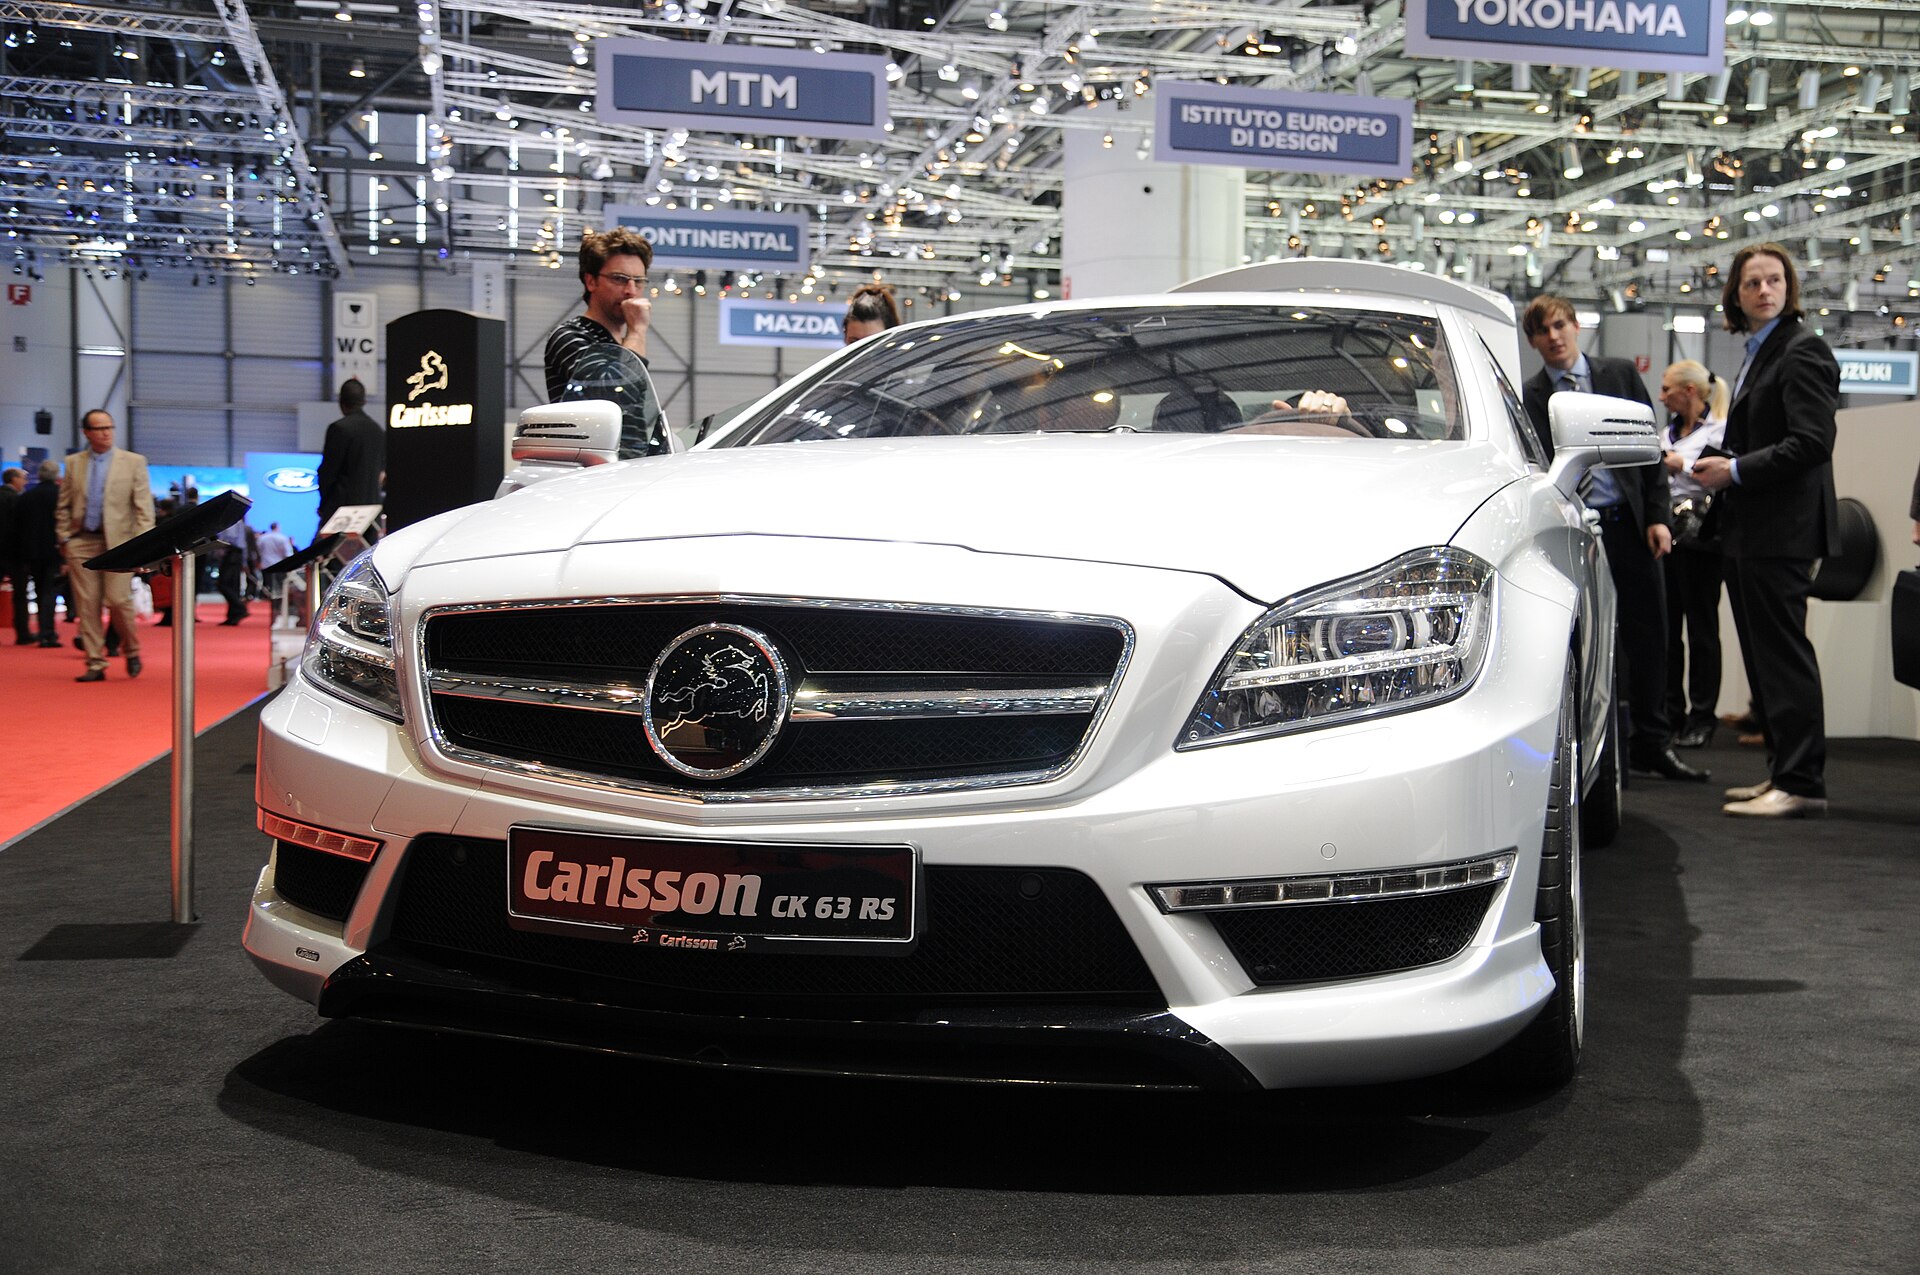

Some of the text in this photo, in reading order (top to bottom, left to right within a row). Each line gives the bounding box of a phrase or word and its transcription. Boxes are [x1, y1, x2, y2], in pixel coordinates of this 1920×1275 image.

[1455, 0, 1687, 38] YOKOHAMA
[690, 68, 798, 110] MTM
[1181, 104, 1388, 137] ISTITUTO EUROPEO
[1231, 128, 1338, 153] DI DESIGN
[754, 312, 840, 336] MAZDA
[337, 338, 373, 354] WC
[1840, 362, 1892, 381] UZUKI
[389, 401, 474, 429] Carlsson
[523, 850, 896, 921] Carlsson CK 63 RS
[659, 934, 719, 950] Carlsson
